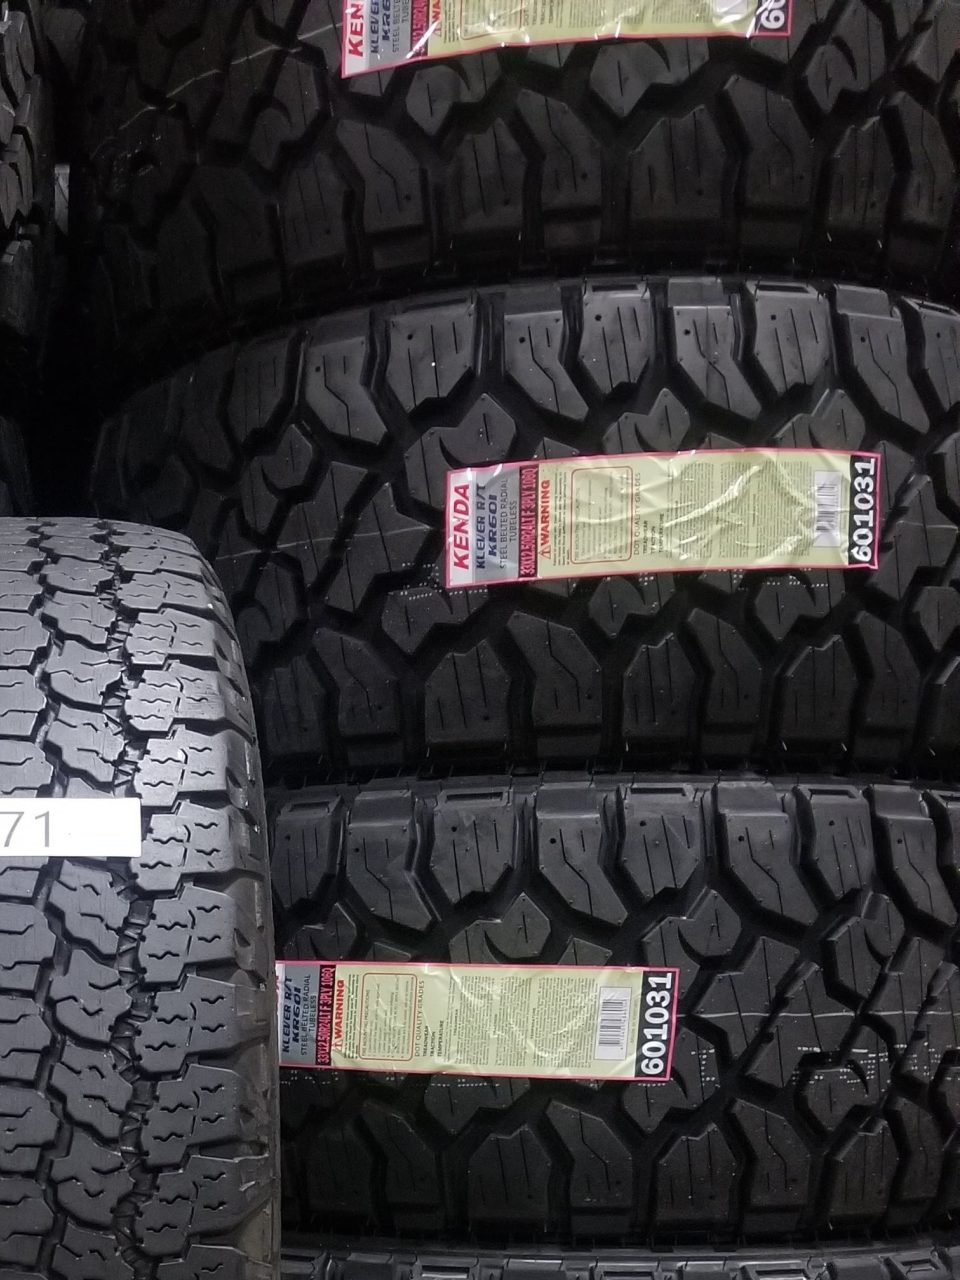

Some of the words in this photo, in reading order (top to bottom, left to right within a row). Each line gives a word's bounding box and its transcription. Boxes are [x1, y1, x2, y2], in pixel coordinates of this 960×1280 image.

[476, 483, 485, 510] R/T
[541, 479, 550, 546] WARNING
[851, 458, 875, 562] 601031
[453, 484, 469, 570] KENDA
[476, 516, 486, 569] KLEVER
[284, 975, 292, 1000] R/T
[293, 986, 301, 1043] KR601
[334, 980, 344, 1039] WARNING
[282, 1005, 291, 1053] KLEVER
[641, 972, 673, 1075] 601031
